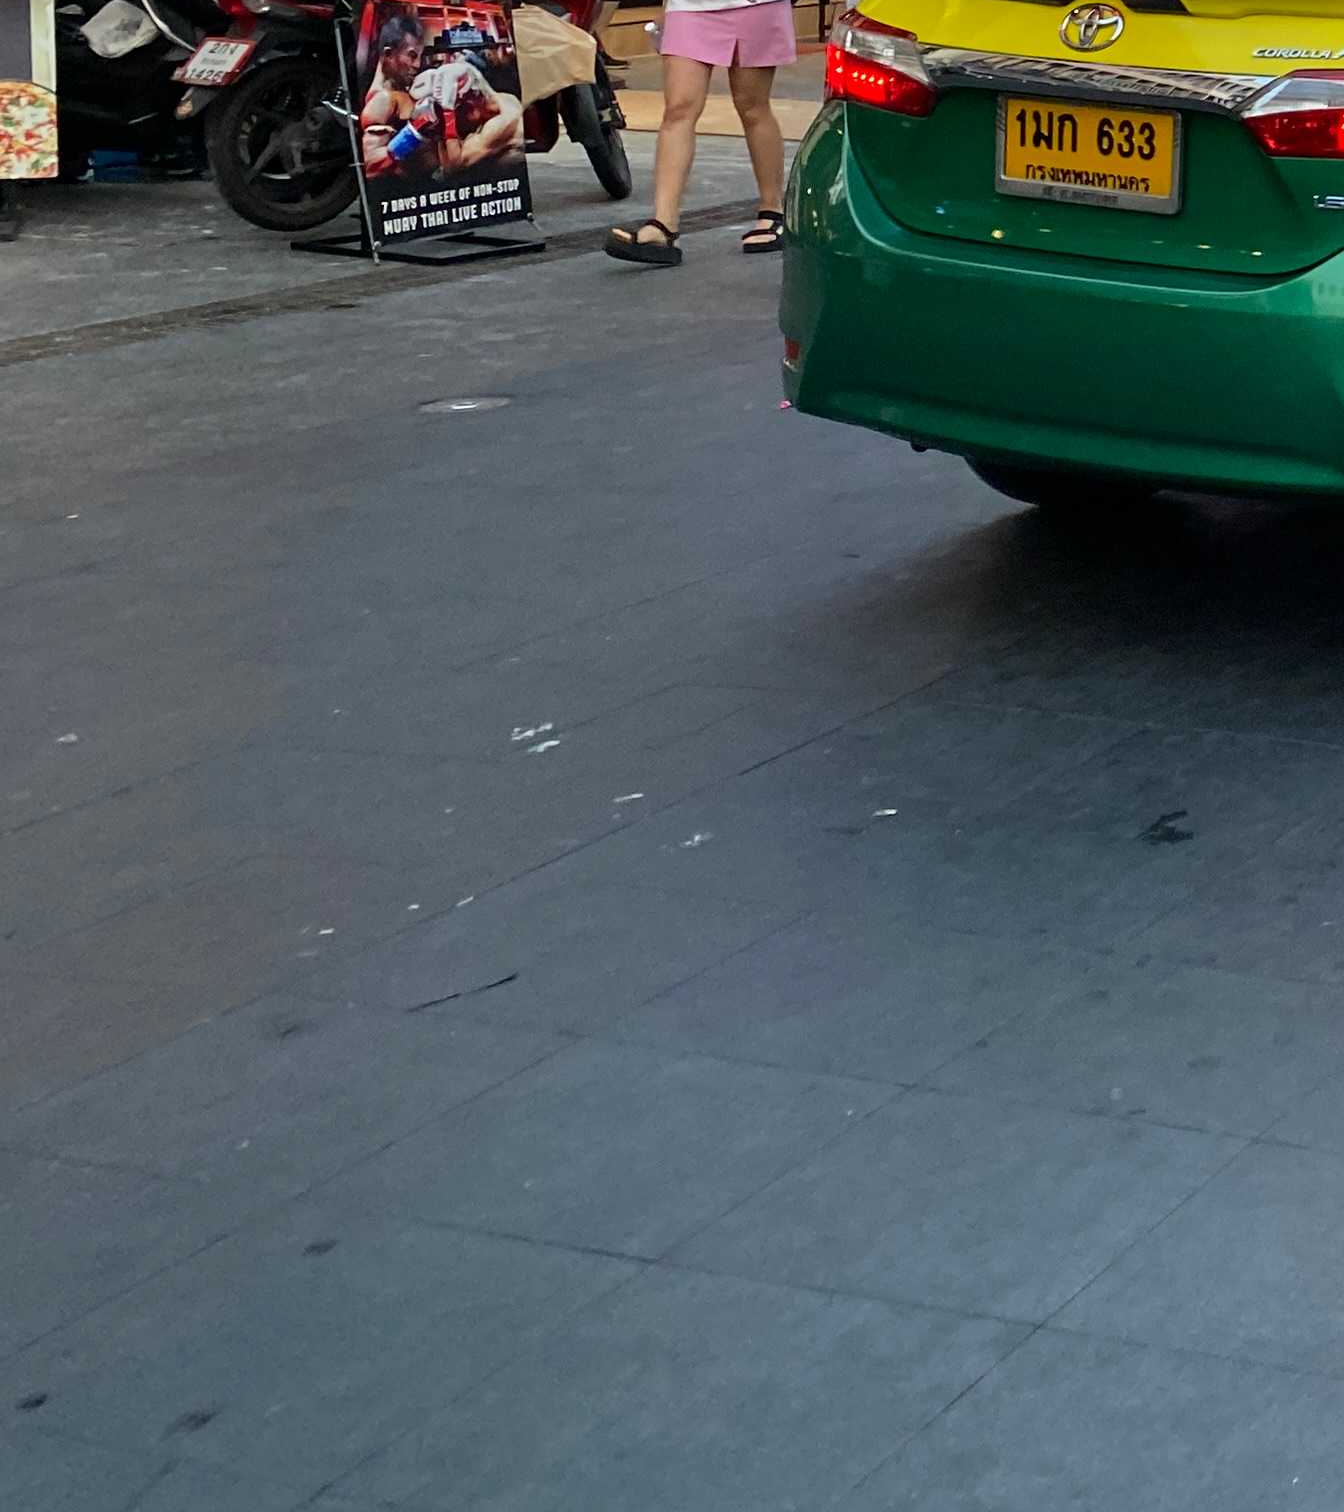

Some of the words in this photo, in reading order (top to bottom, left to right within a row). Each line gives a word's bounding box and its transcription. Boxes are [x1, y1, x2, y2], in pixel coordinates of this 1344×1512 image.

[1252, 47, 1332, 60] COROLLA
[1016, 108, 1078, 153] 1มก
[1097, 117, 1157, 161] 633
[381, 201, 389, 214] 7
[391, 196, 417, 212] DAYS
[420, 194, 427, 208] A
[429, 189, 457, 205] WEEK
[459, 187, 471, 200] OF
[473, 178, 520, 198] NON-STOP
[1025, 163, 1151, 193] กรงเทพมหานคร
[383, 215, 418, 236] MUAY
[421, 210, 449, 228] THAI
[452, 204, 478, 223] LIVE
[481, 196, 522, 217] ACTION
